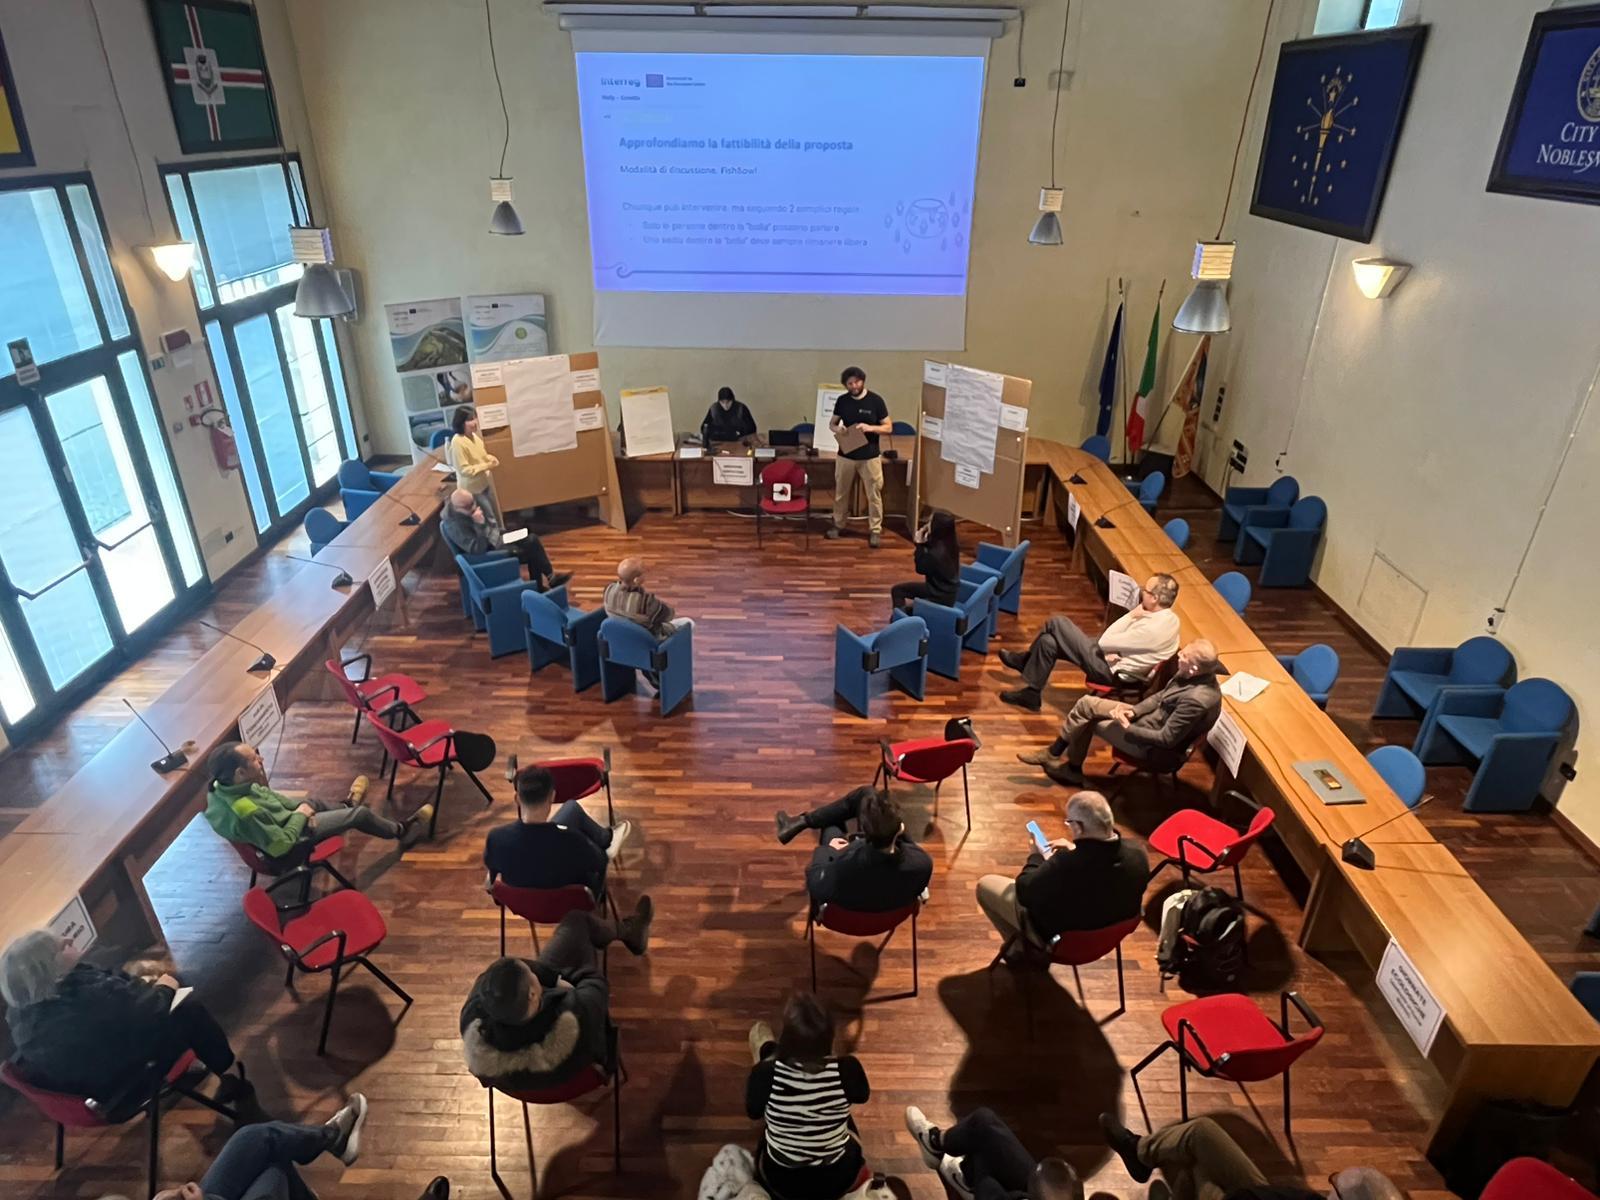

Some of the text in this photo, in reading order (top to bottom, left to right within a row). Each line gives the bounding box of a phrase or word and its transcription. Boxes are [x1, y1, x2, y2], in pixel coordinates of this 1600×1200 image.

[619, 137, 854, 152] Approfondiamo la fattibilità della proposta
[620, 165, 658, 174] Modalità
[659, 165, 668, 174] di
[789, 203, 795, 213] 2
